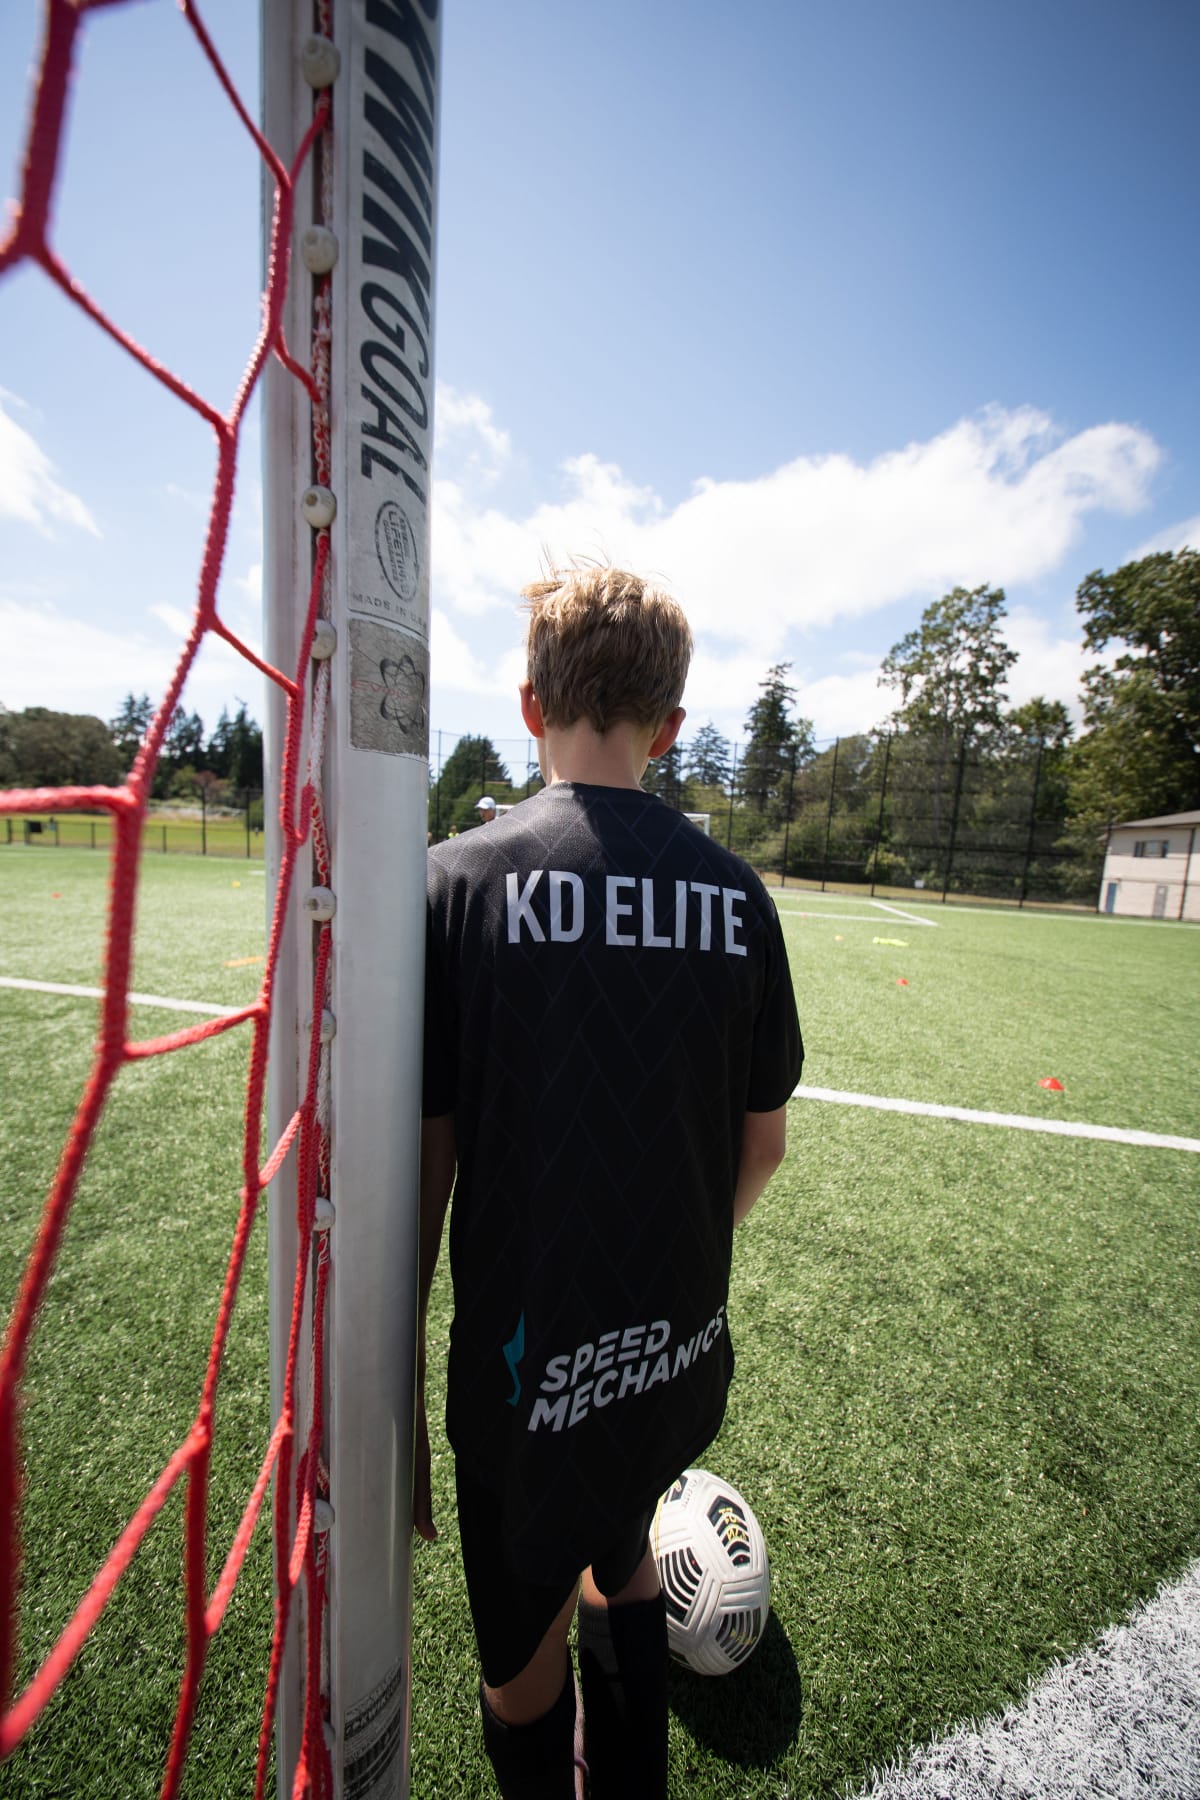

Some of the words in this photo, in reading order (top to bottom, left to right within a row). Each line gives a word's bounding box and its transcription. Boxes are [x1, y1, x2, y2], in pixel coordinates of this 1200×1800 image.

[506, 869, 585, 944] KD
[605, 875, 748, 957] ELITE
[527, 1305, 725, 1432] MECHANICS
[539, 1320, 671, 1392] SPEED
